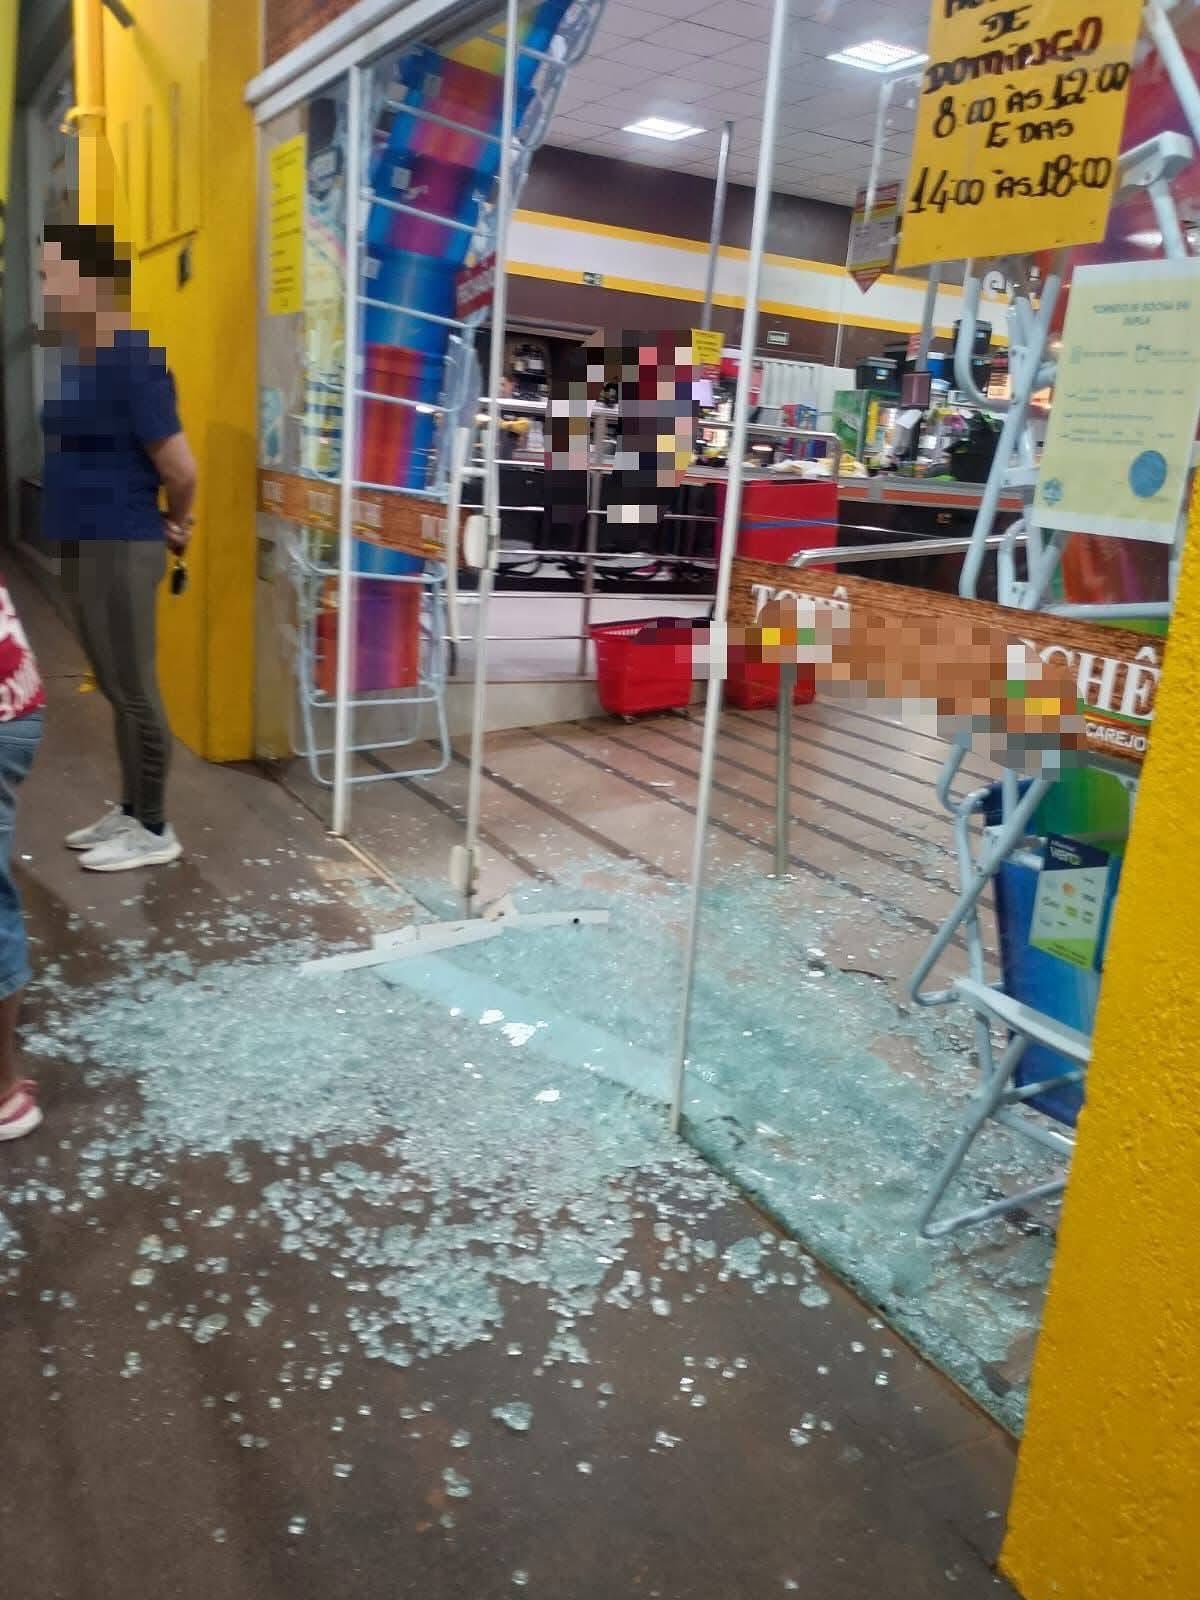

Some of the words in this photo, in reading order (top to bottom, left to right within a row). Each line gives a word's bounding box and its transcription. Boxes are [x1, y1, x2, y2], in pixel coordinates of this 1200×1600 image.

[979, 5, 1032, 43] DE
[985, 121, 1010, 148] E
[1017, 119, 1074, 142] DAS
